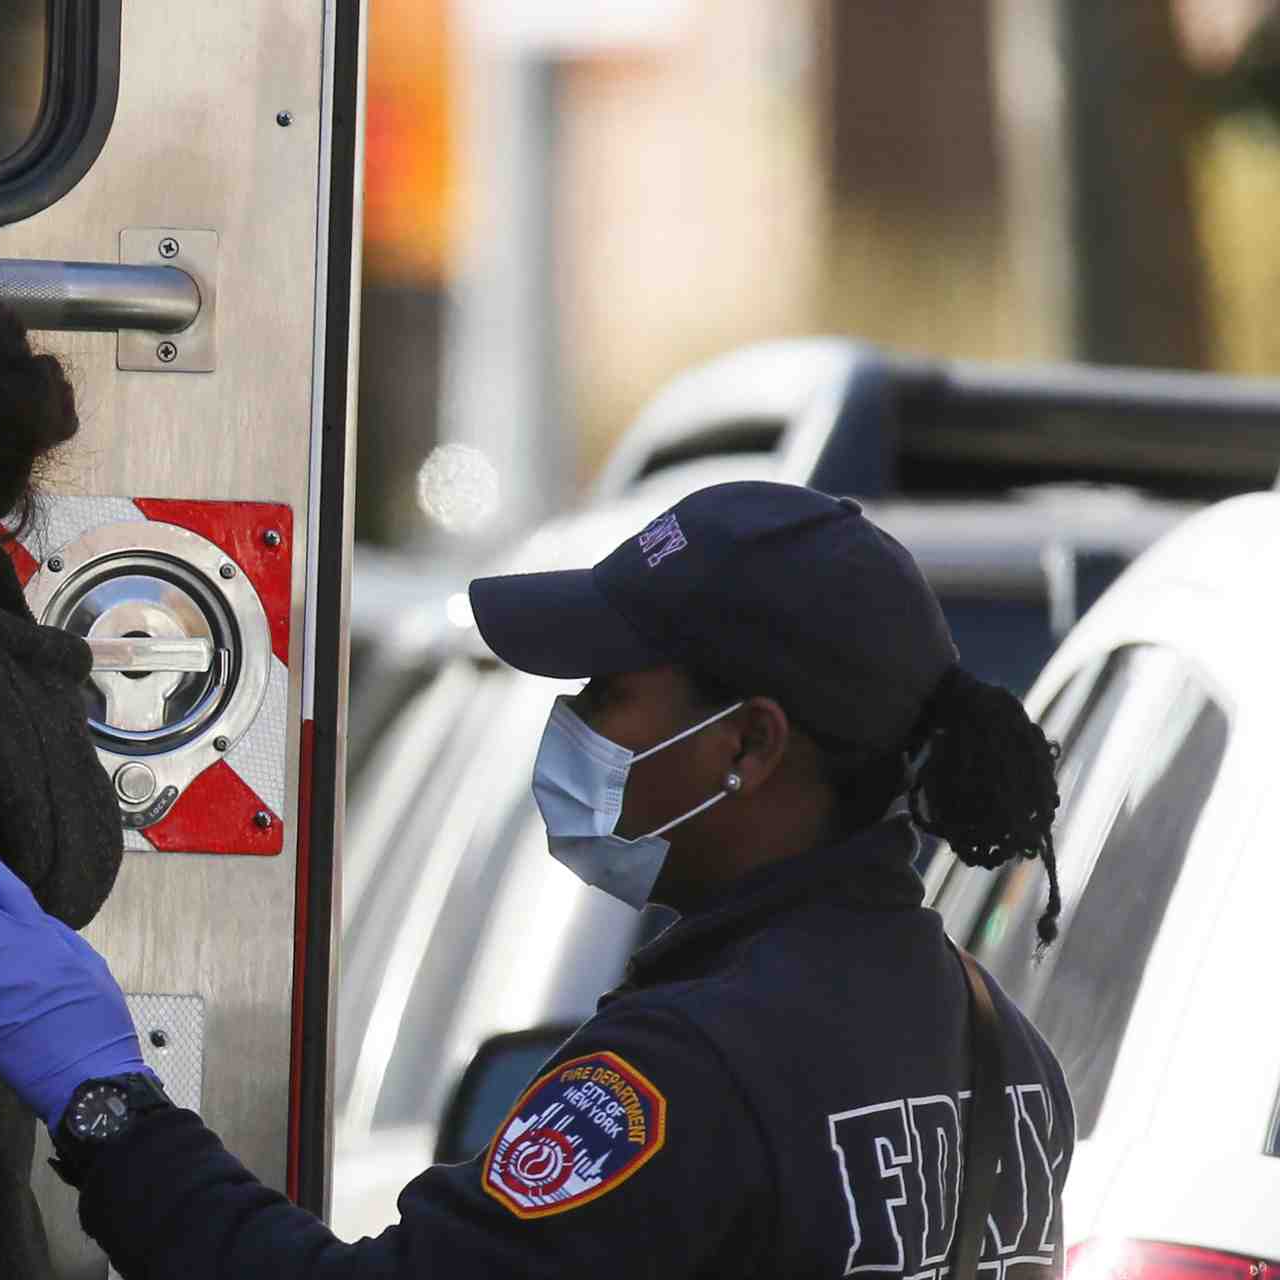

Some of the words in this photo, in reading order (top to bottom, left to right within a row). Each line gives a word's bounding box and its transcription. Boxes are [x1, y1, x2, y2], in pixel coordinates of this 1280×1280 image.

[561, 1066, 592, 1083] FIRE
[592, 1067, 646, 1145] DEPARTMENT
[562, 1086, 594, 1112] NEW
[587, 1103, 623, 1140] YORK
[582, 1081, 610, 1105] CITY
[606, 1101, 625, 1119] OF
